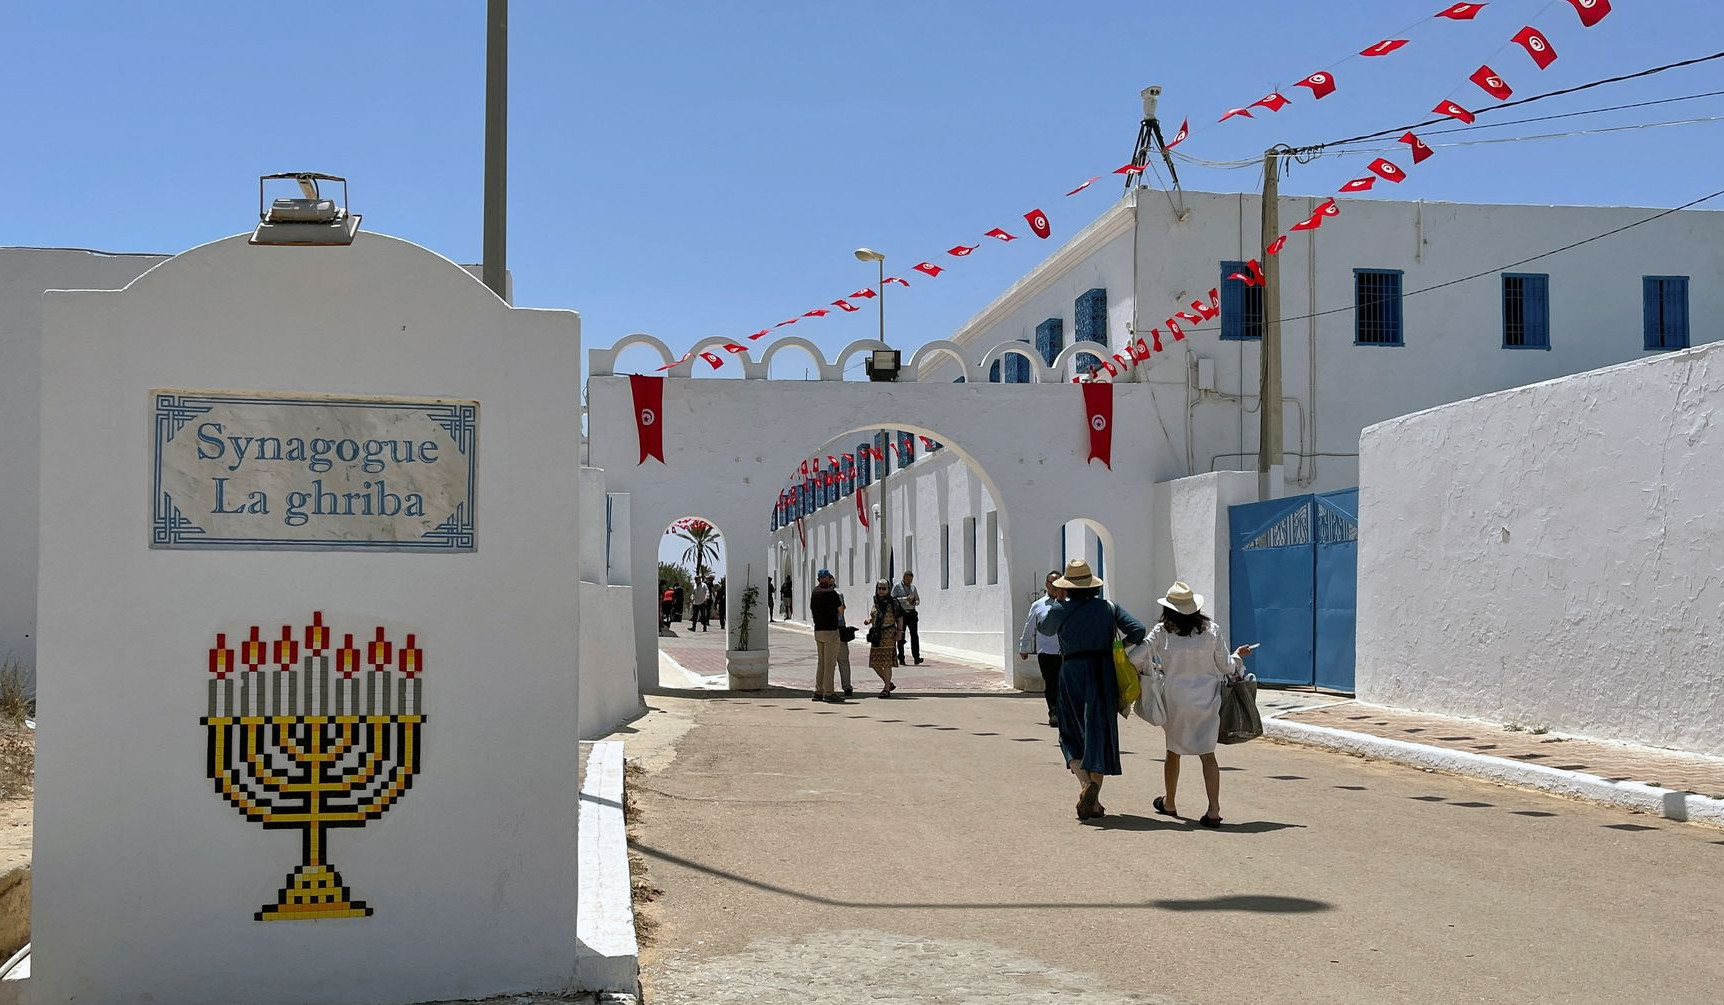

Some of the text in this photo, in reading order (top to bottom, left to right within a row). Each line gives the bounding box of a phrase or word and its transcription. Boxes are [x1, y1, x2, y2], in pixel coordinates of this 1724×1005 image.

[197, 422, 439, 473] Synagogue
[210, 477, 425, 526] La ghriba
